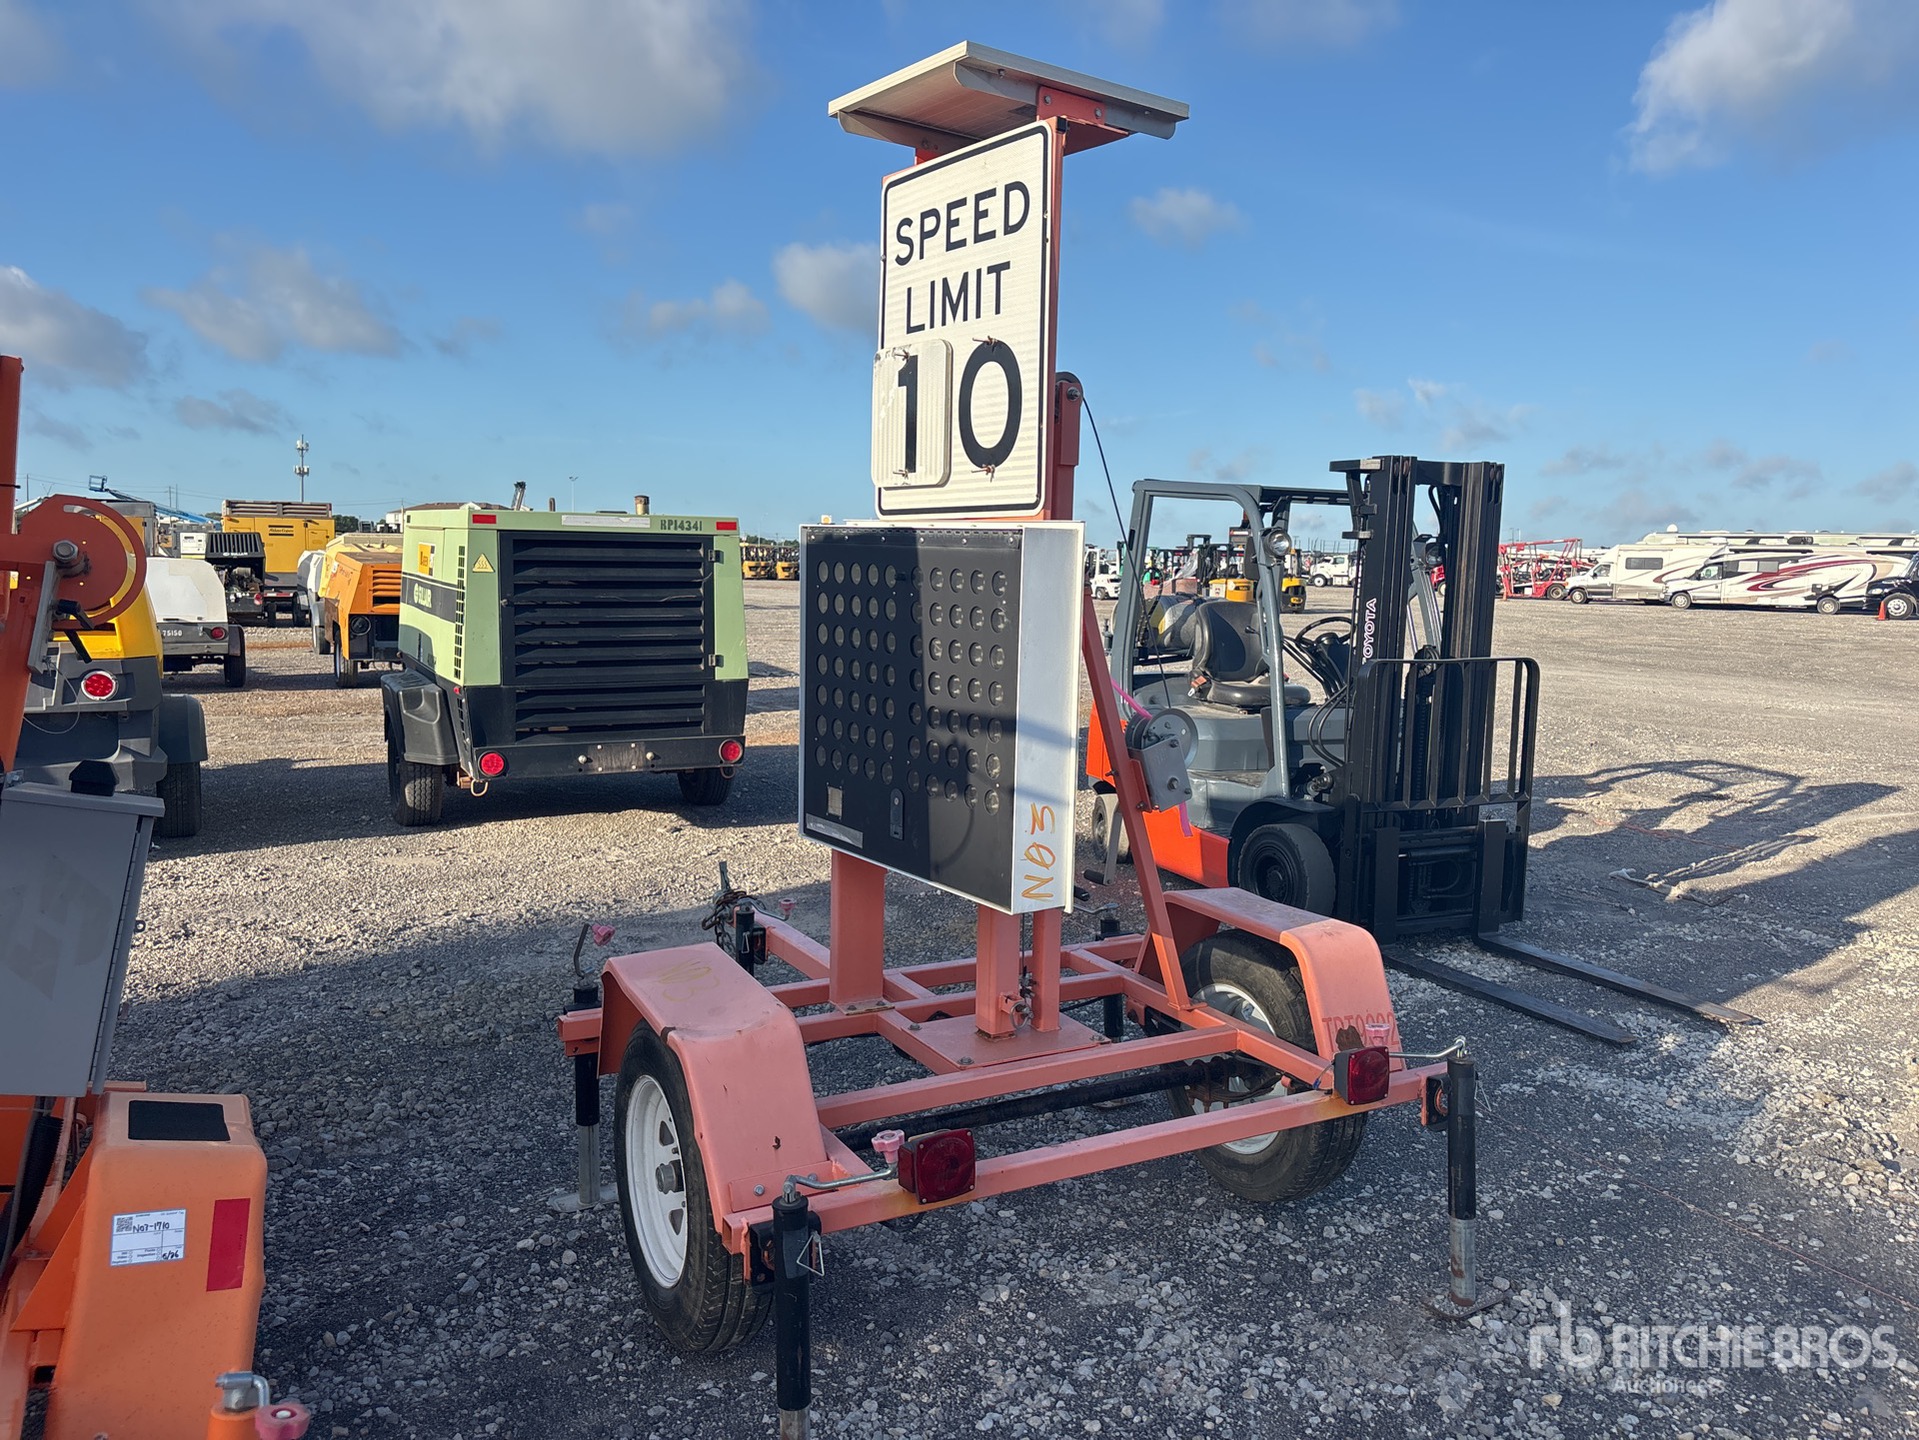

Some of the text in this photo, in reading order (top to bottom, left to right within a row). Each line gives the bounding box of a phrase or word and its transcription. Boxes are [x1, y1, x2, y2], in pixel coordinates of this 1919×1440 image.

[895, 180, 1030, 266] SPEED
[906, 260, 1011, 335] LIMIT
[898, 340, 1022, 473] 10
[660, 519, 703, 531] RP14341
[1361, 597, 1377, 665] OYOTA
